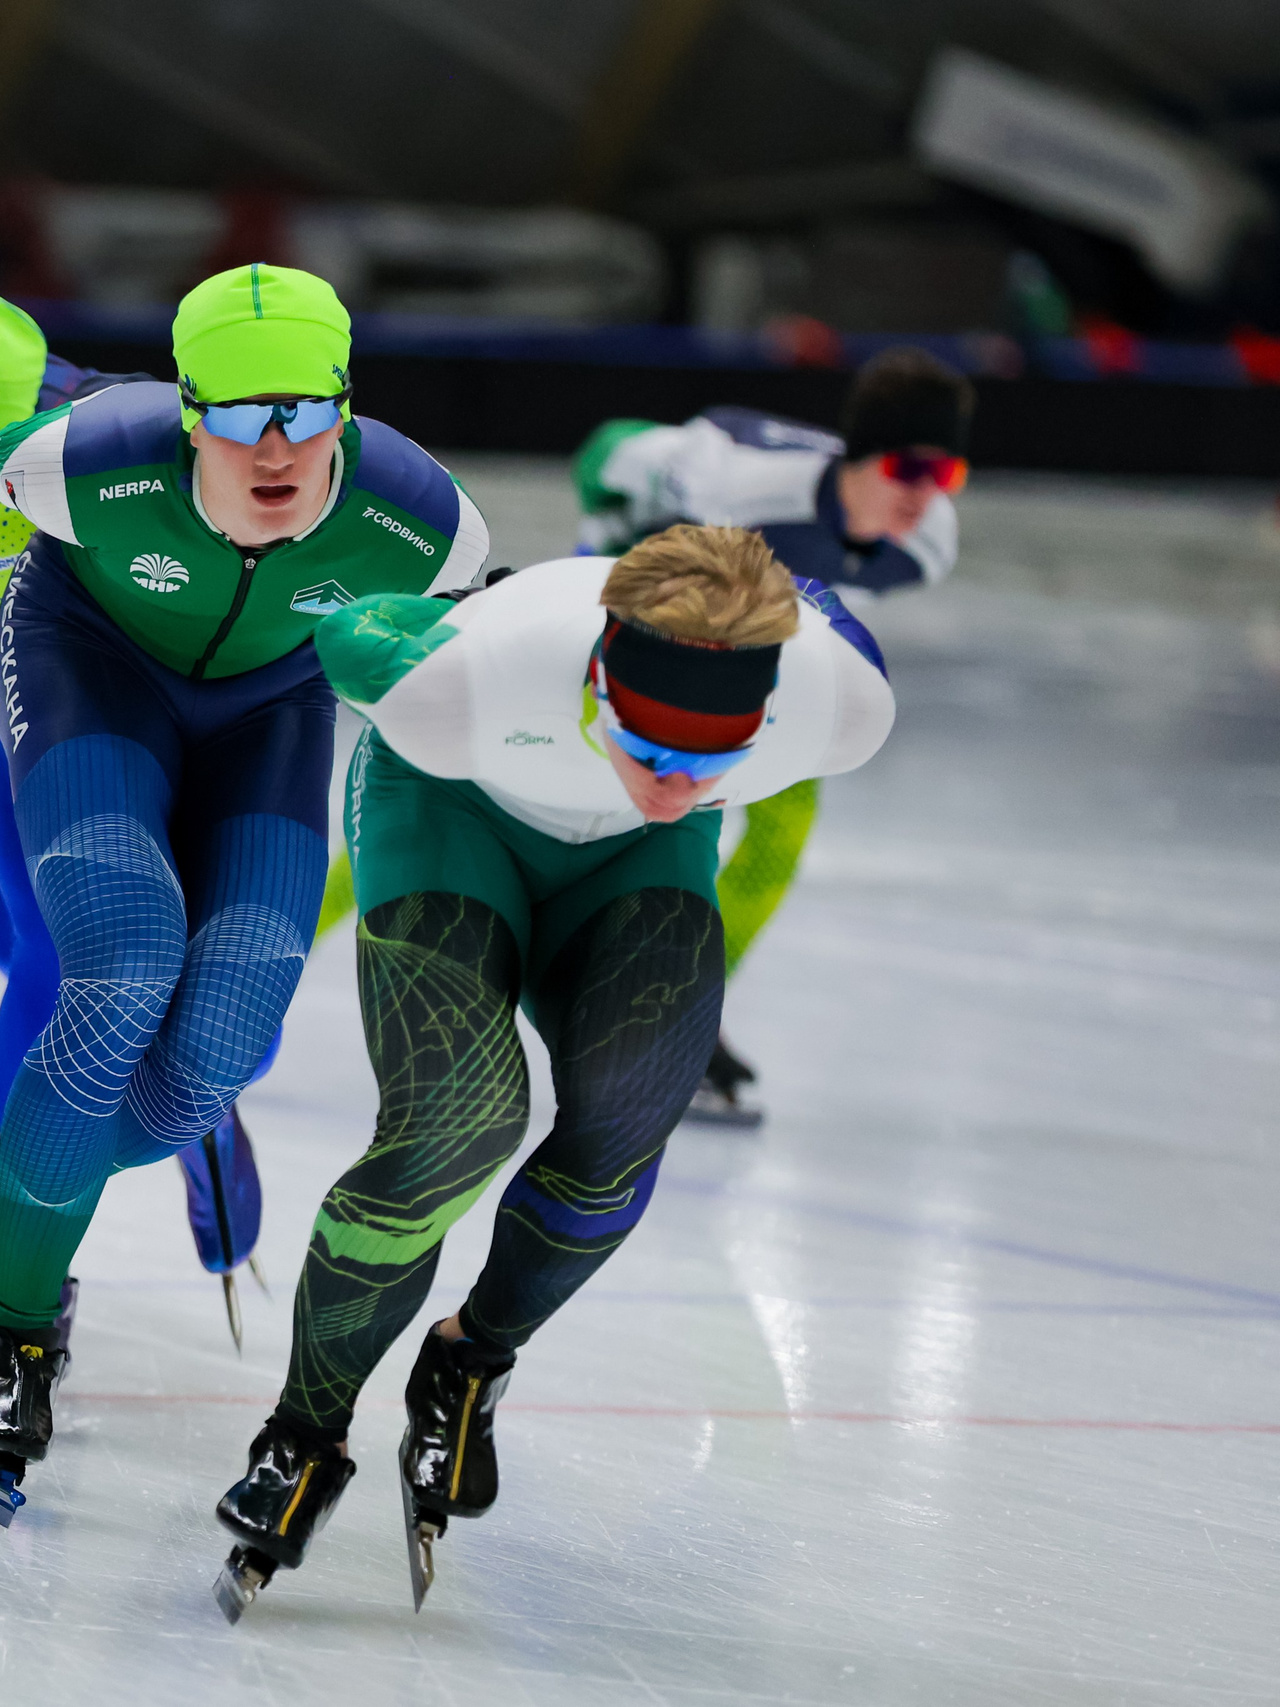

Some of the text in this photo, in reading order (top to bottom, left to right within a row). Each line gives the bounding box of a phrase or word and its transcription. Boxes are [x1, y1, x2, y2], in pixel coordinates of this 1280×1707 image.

[99, 479, 165, 502] NERPA
[373, 512, 436, 556] сервико
[504, 735, 556, 747] FORMA
